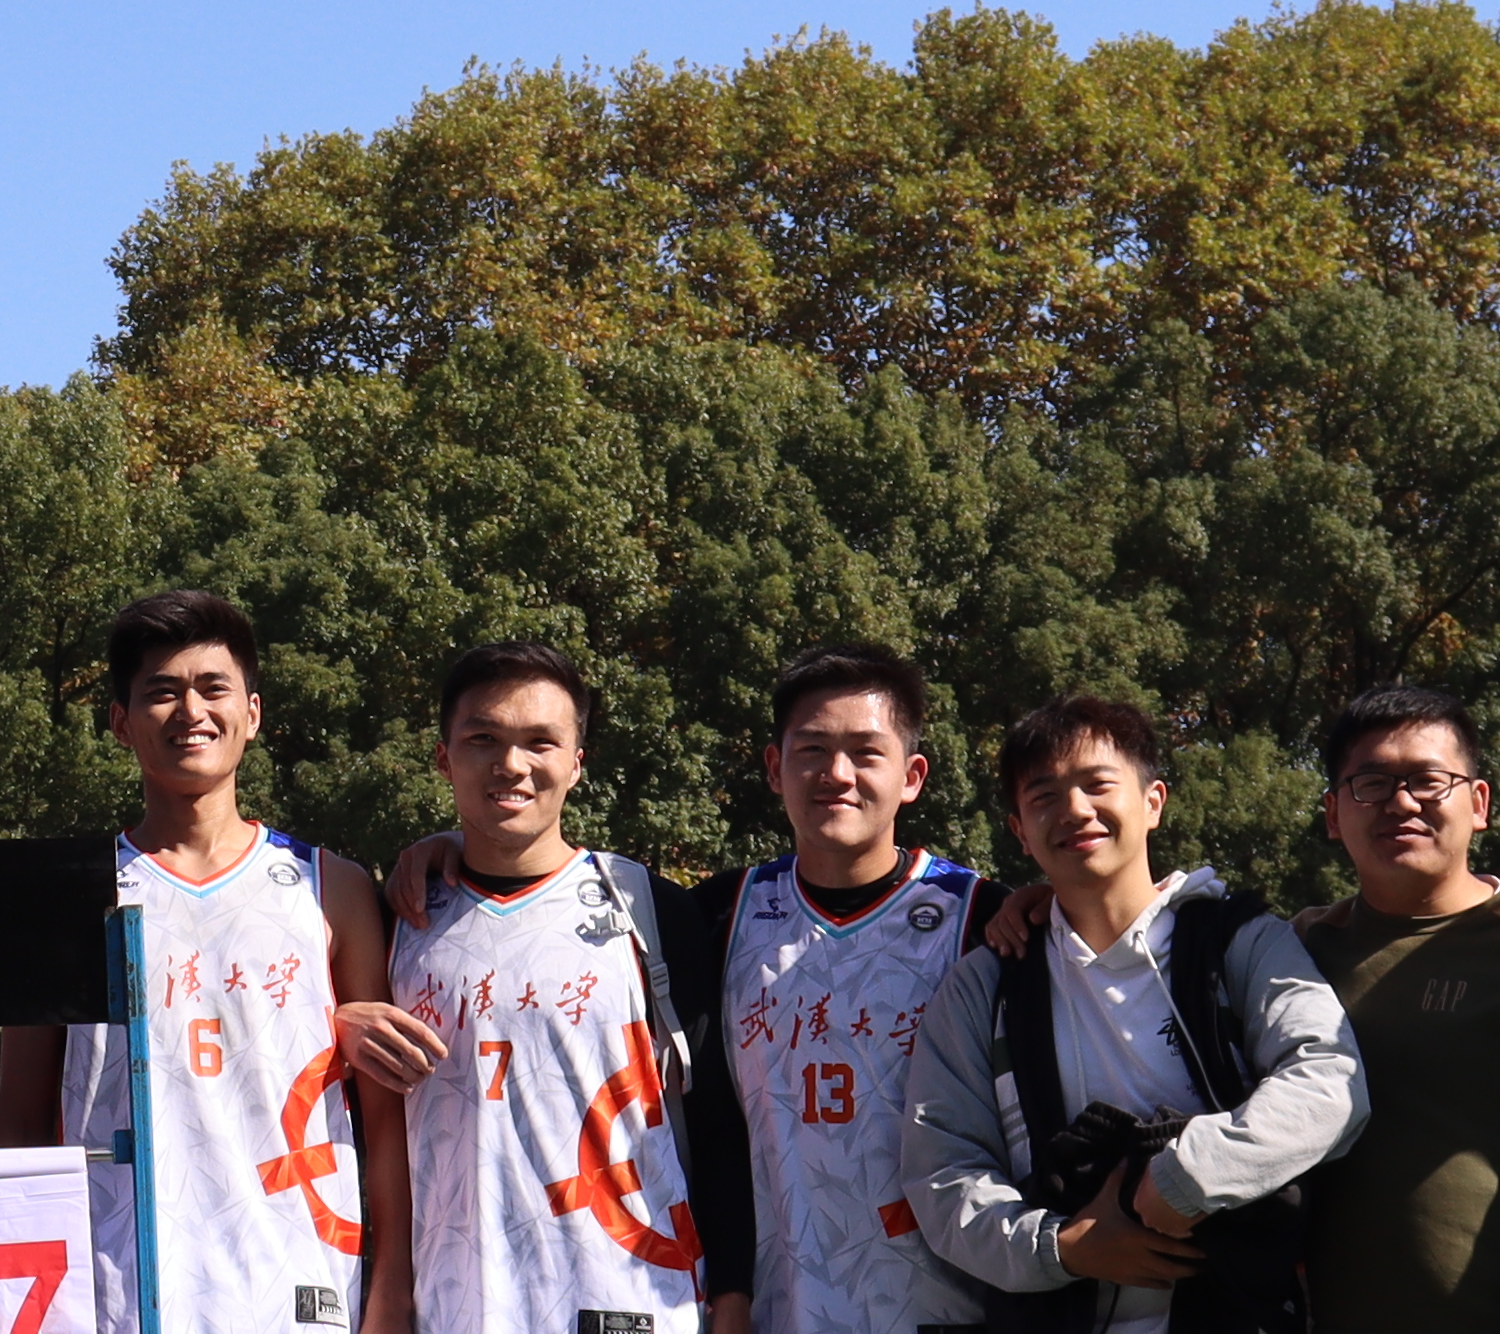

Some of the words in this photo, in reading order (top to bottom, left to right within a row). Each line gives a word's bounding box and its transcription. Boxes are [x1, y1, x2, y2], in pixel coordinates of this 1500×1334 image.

[1421, 978, 1468, 1012] GAP
[188, 1018, 223, 1077] 6
[479, 1041, 513, 1101] 7
[802, 1063, 856, 1124] 13
